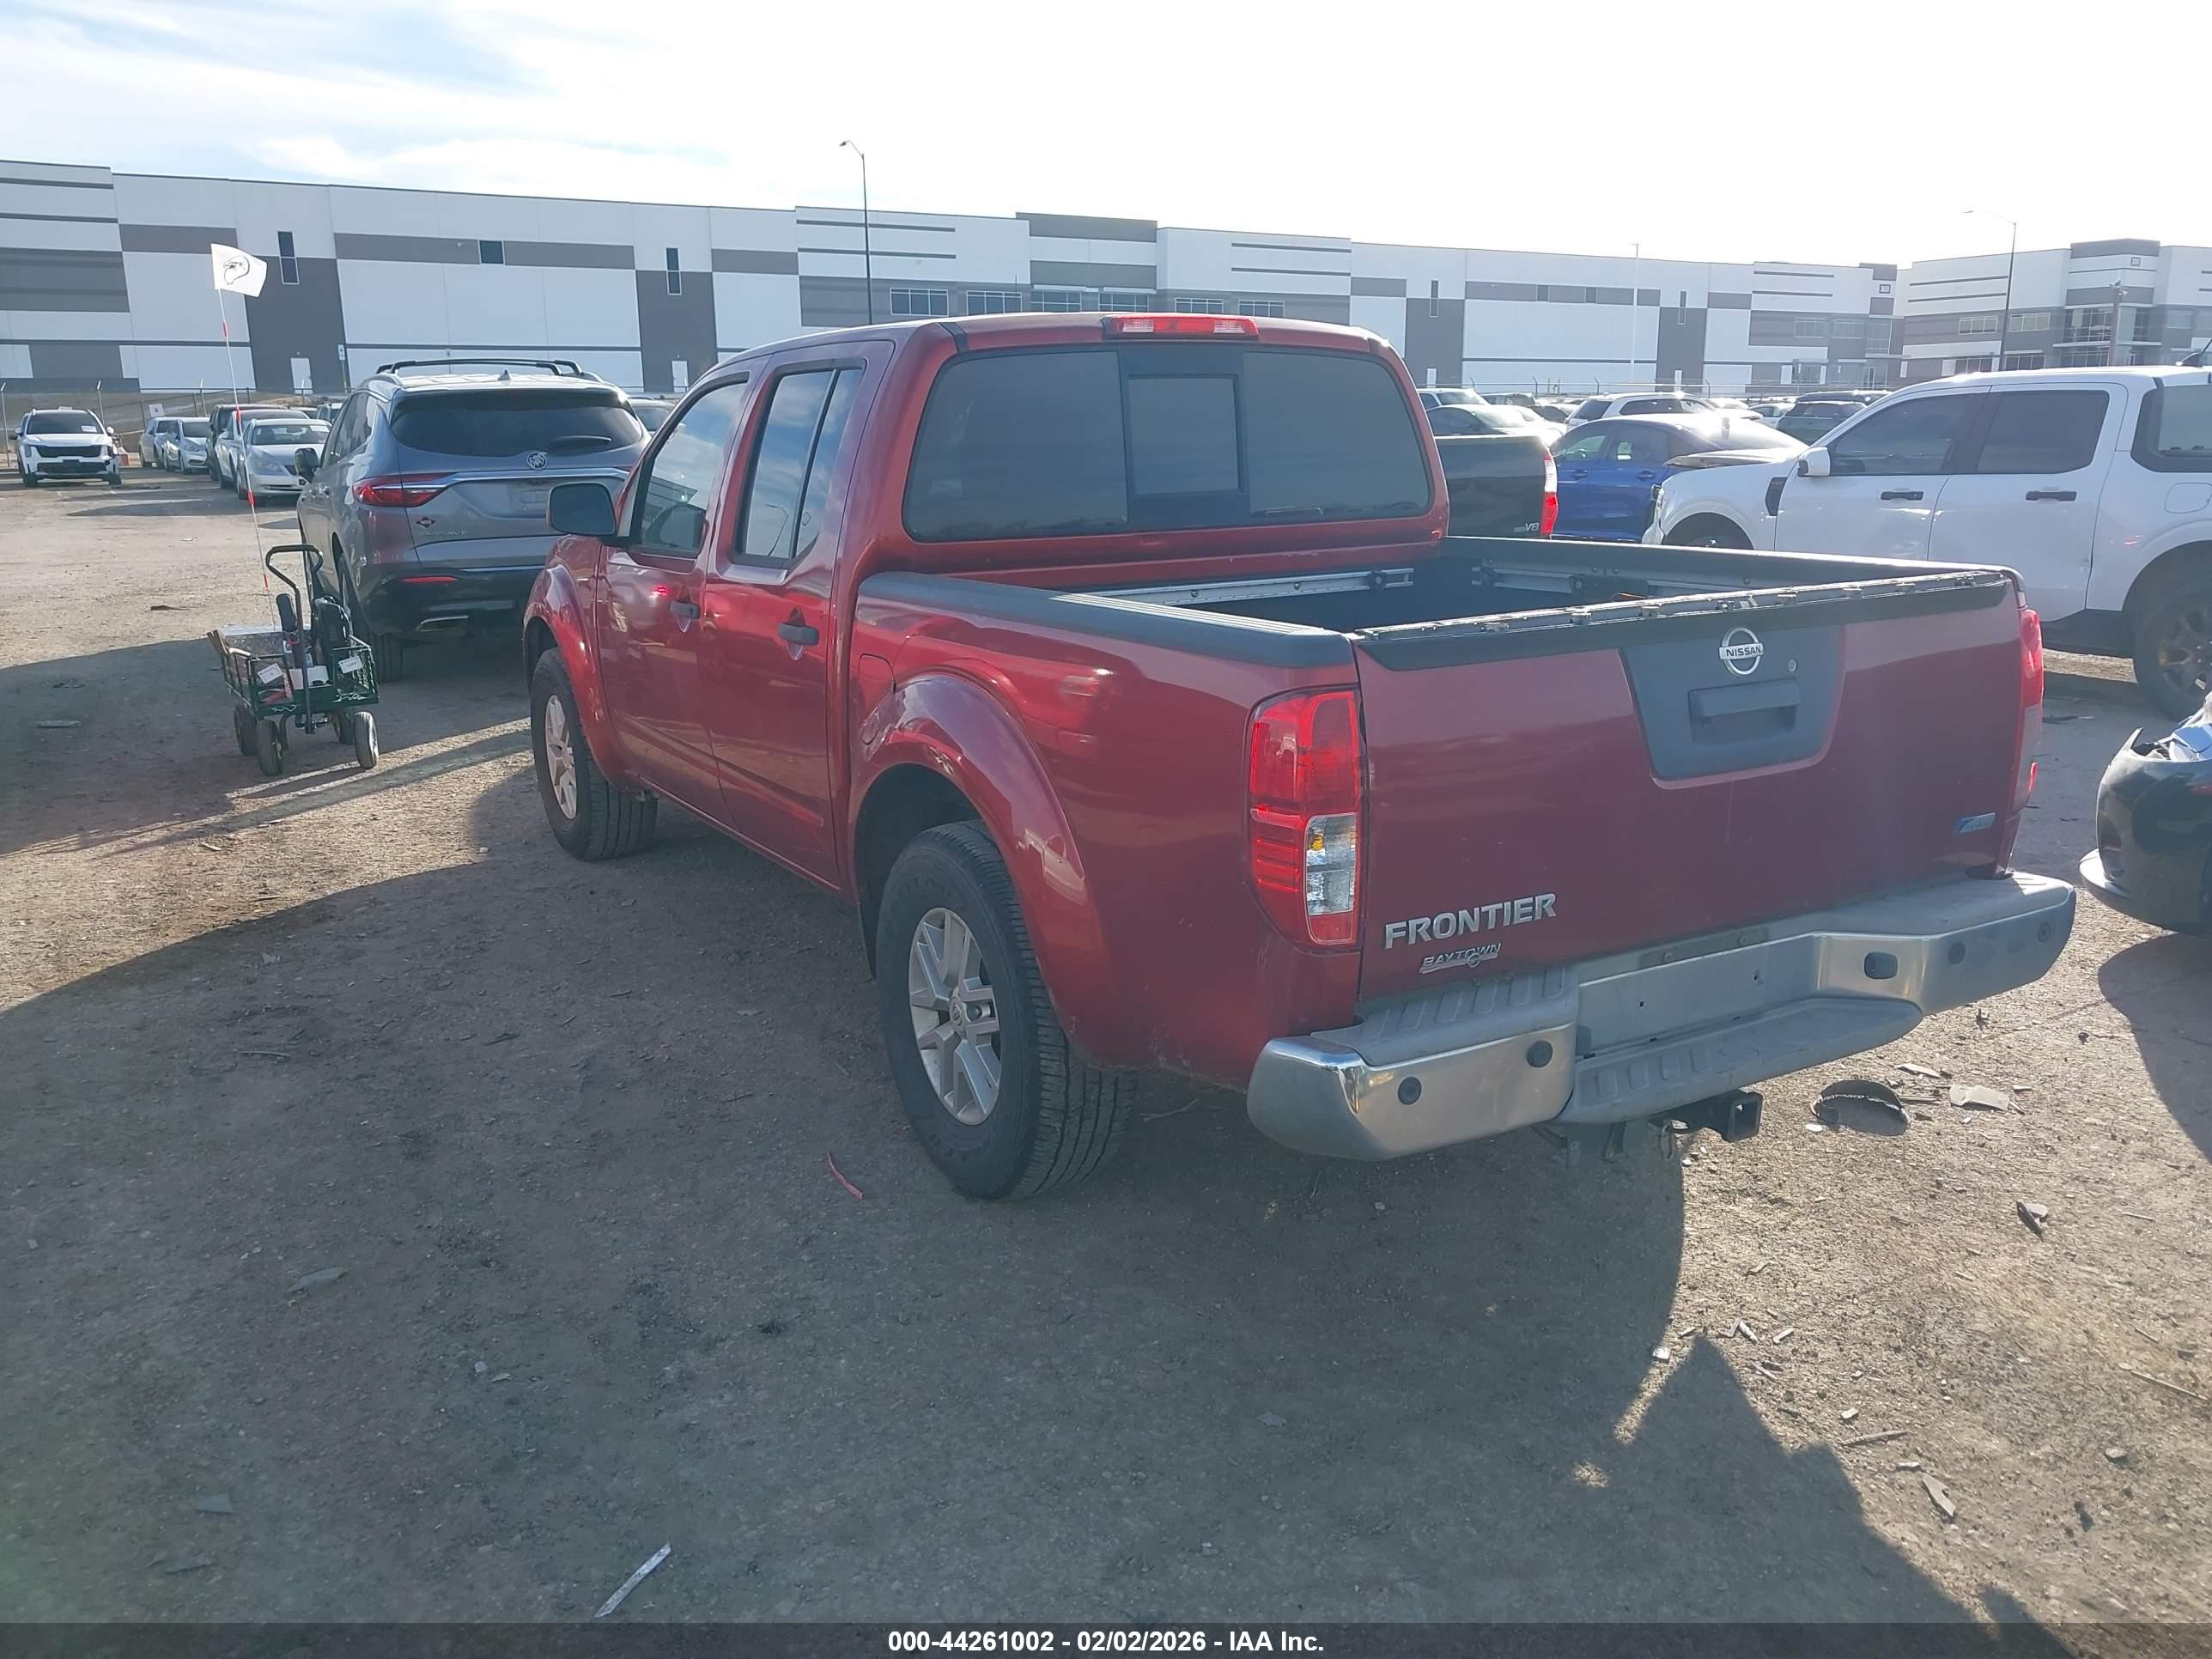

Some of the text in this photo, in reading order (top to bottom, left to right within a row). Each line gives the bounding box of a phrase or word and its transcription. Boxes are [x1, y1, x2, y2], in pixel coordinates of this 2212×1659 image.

[1524, 522, 1540, 532] V8
[1725, 645, 1761, 656] NISSAN
[1384, 893, 1557, 950] FRONTIER
[1422, 942, 1502, 967] BAYTOWN
